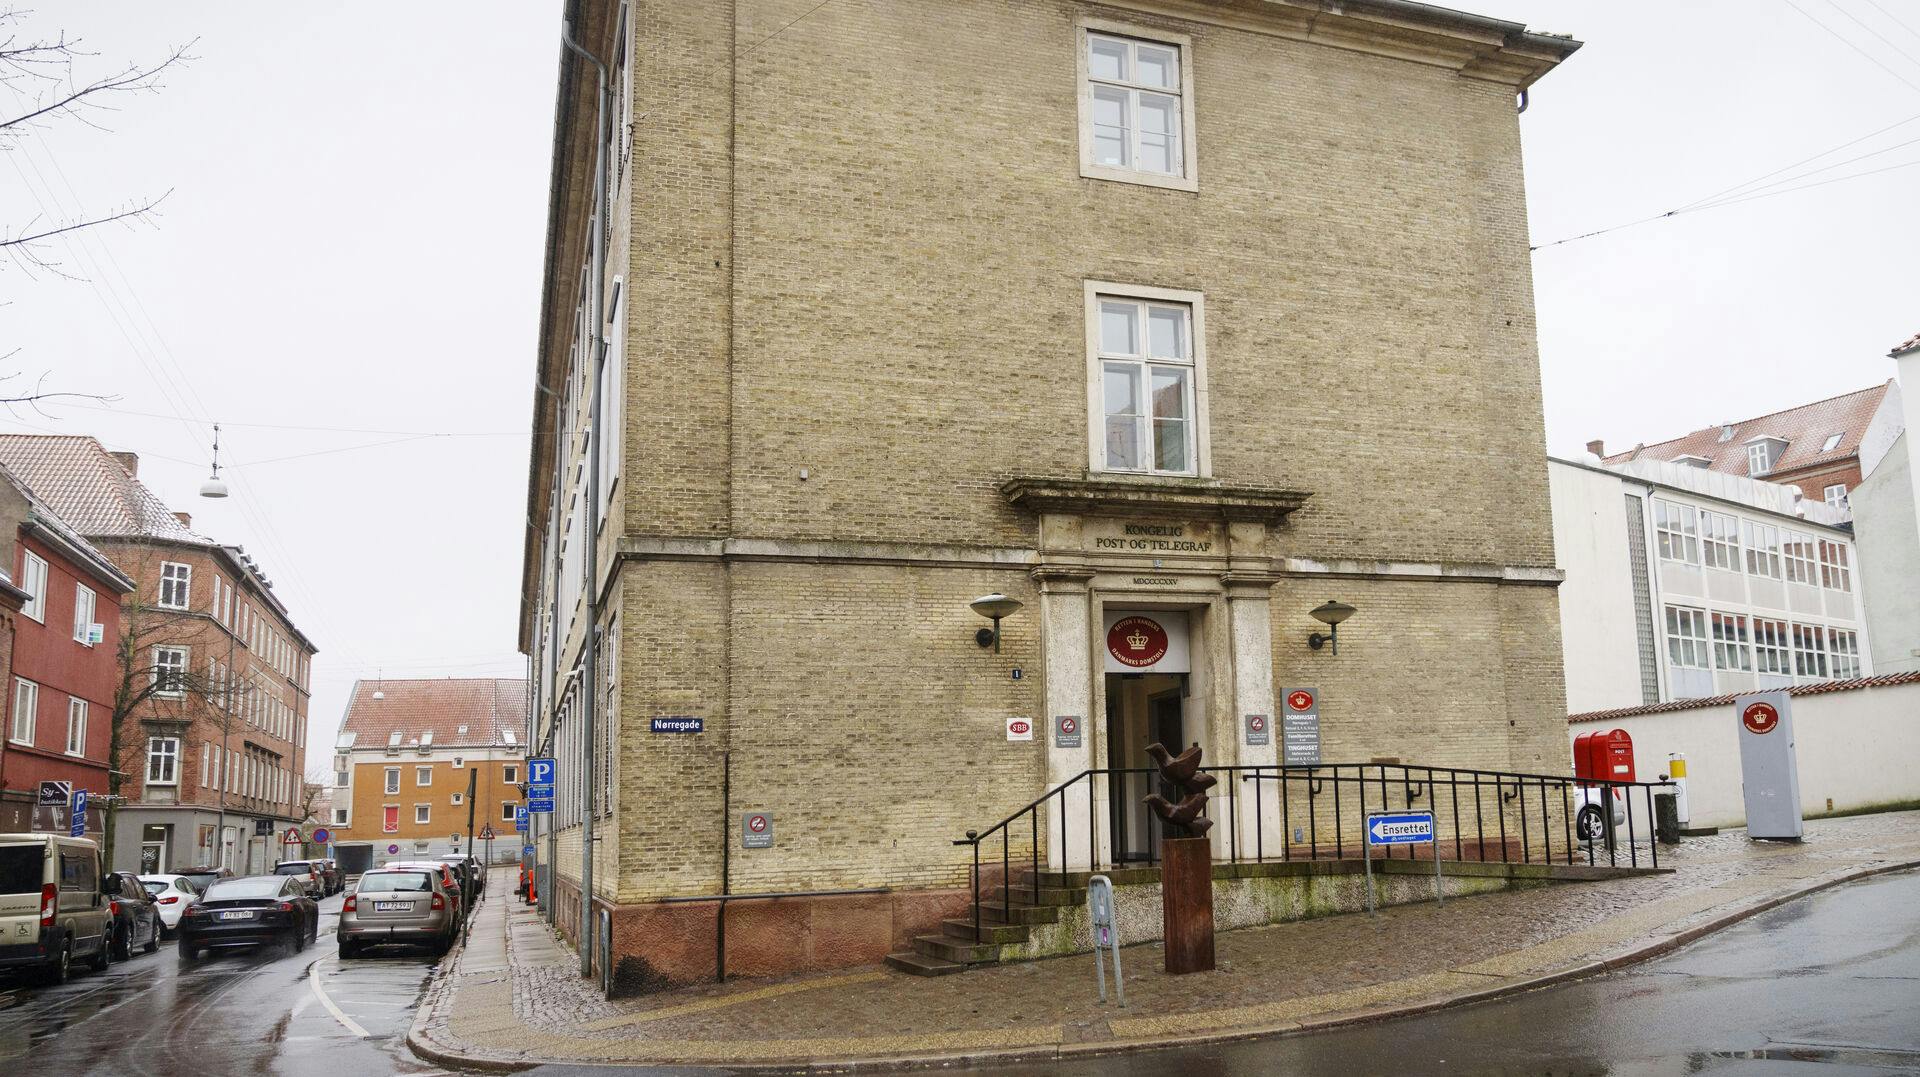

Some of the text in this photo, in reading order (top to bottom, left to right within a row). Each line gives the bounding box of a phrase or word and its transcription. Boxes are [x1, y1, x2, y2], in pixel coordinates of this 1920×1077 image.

[1125, 525, 1183, 537] KONGELIG
[1096, 538, 1212, 551] POST OG TELEGRAF
[1111, 647, 1165, 666] DANMARKS DOMSTOLE
[654, 719, 700, 731] Nørregade
[1012, 723, 1028, 732] SBB
[533, 763, 550, 782] P
[41, 787, 60, 798] Sy-
[76, 793, 85, 811] P
[518, 808, 526, 818] P
[1383, 824, 1429, 835] Ensrettet
